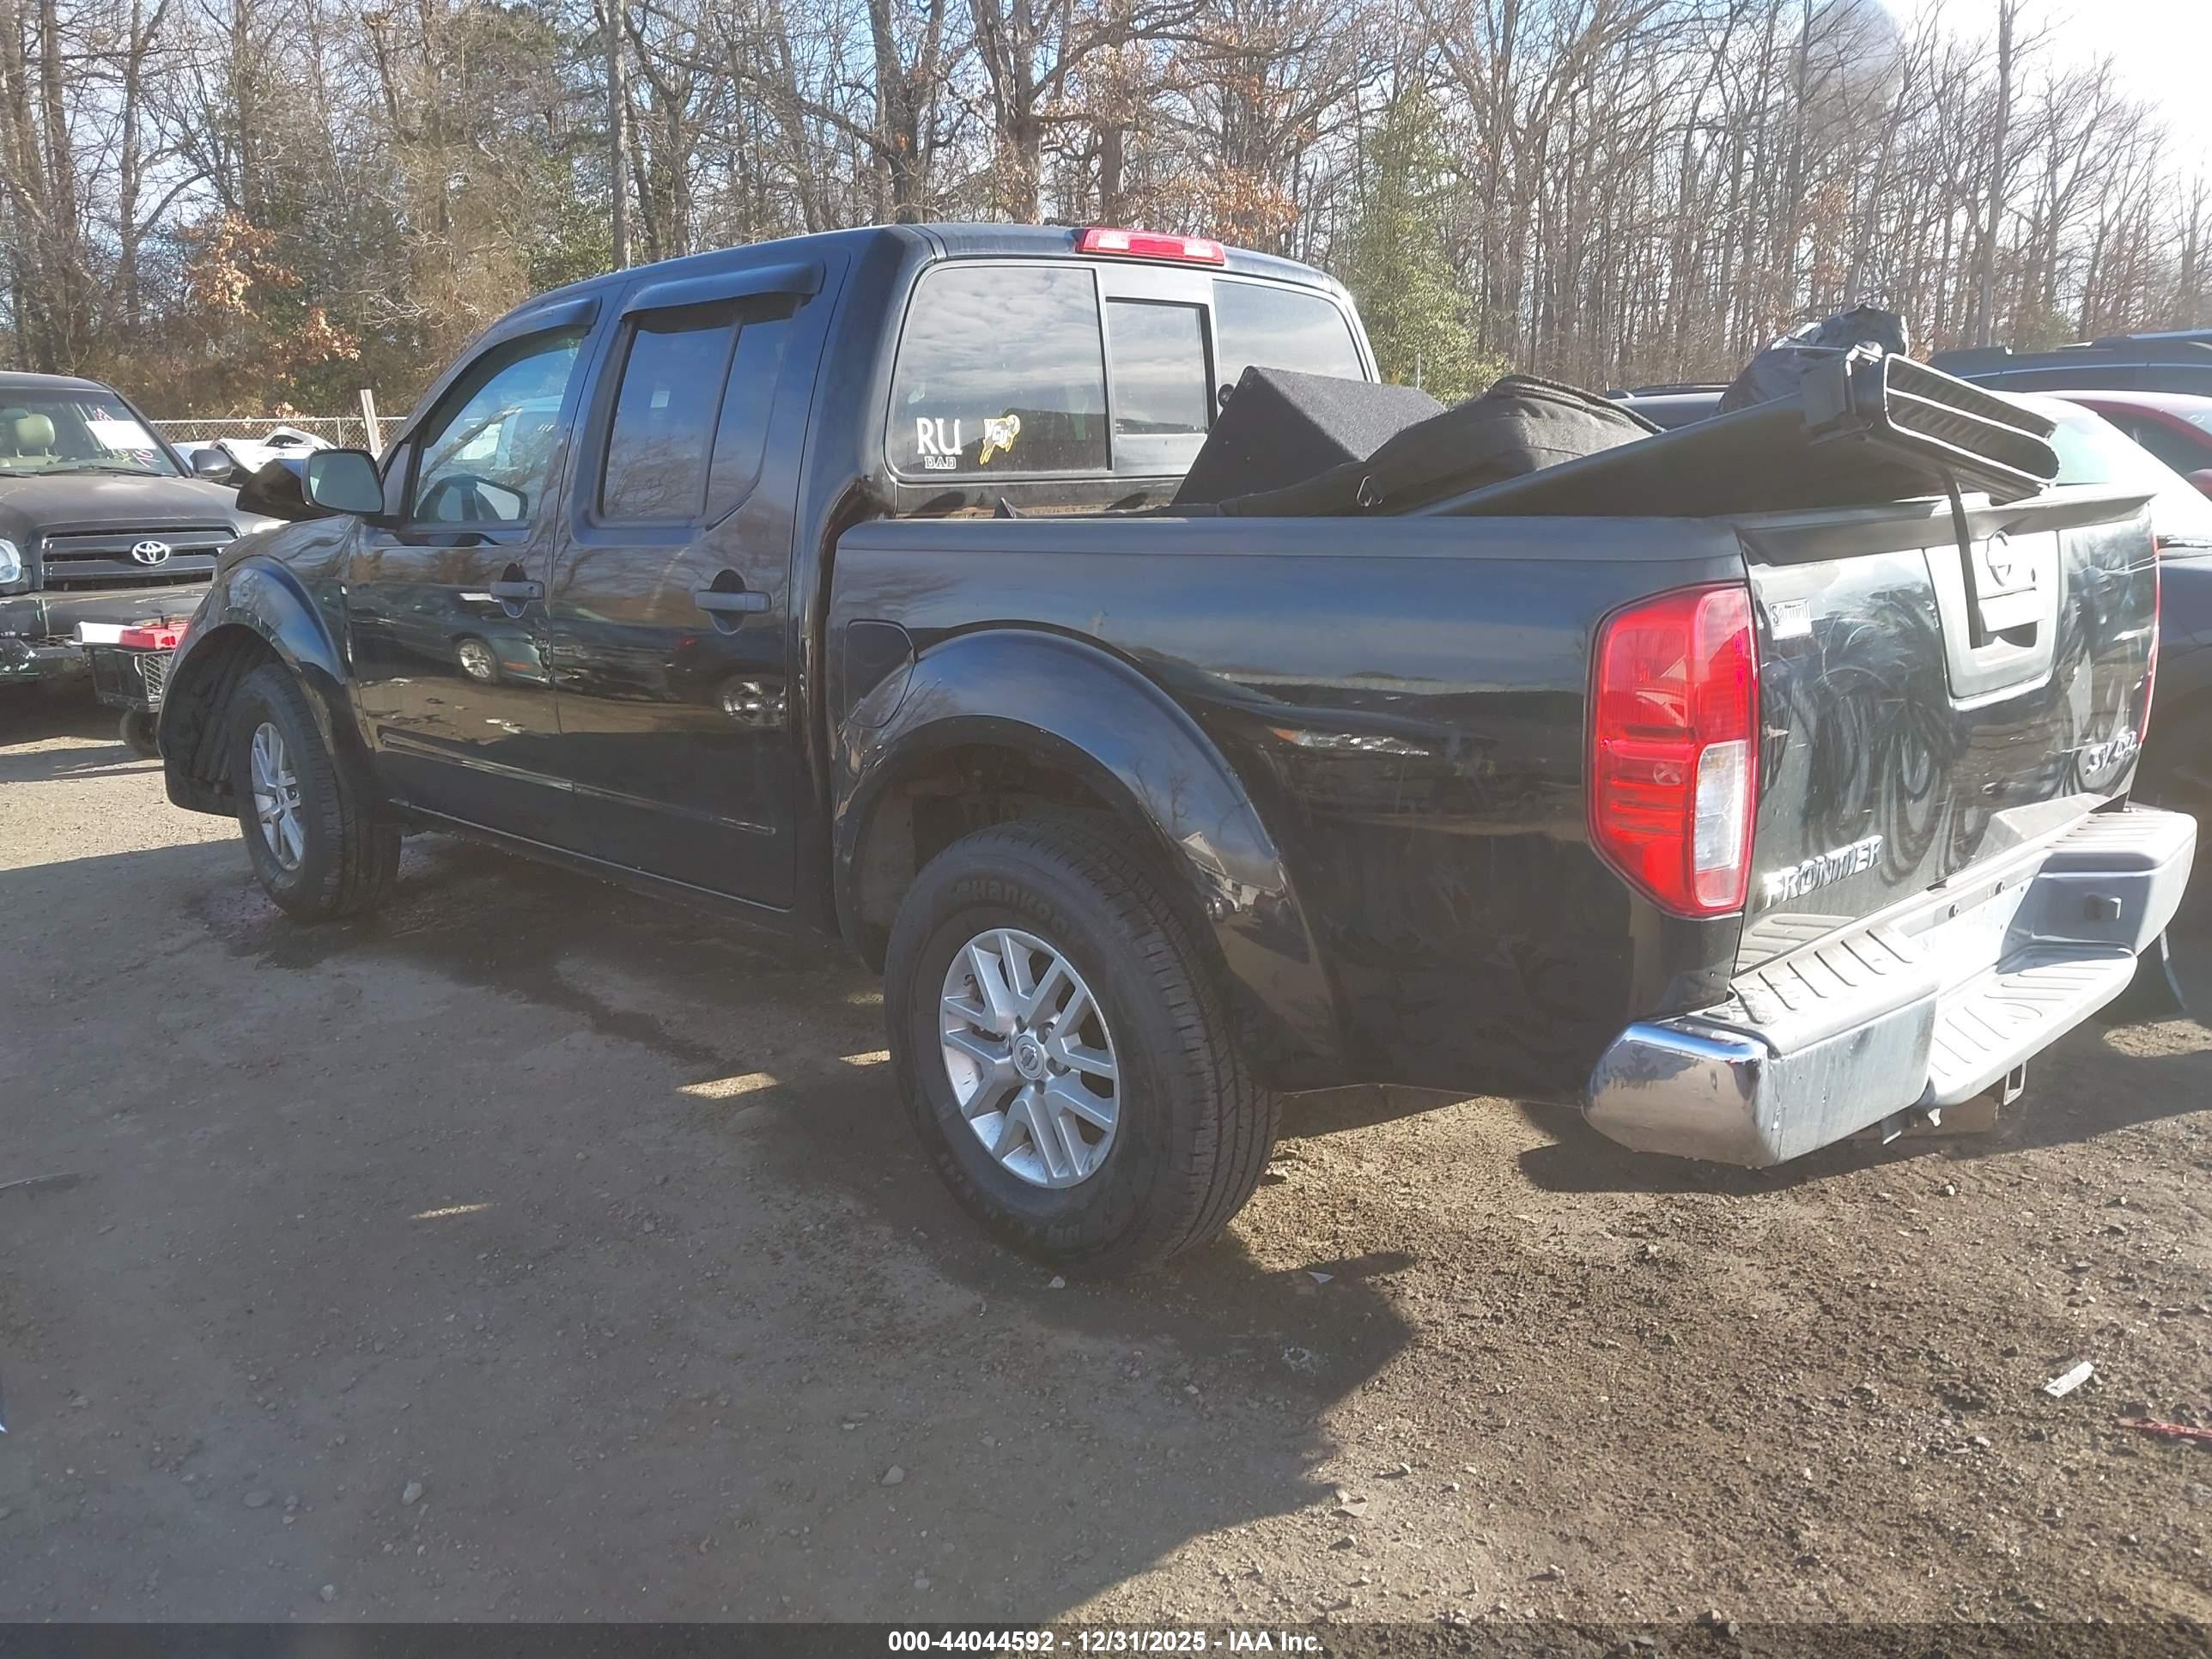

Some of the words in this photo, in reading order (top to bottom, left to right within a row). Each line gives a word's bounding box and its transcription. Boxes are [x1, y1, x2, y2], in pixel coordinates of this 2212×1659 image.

[916, 417, 963, 455] RU
[925, 456, 957, 470] DAD
[1763, 835, 1883, 908] FRONTIER
